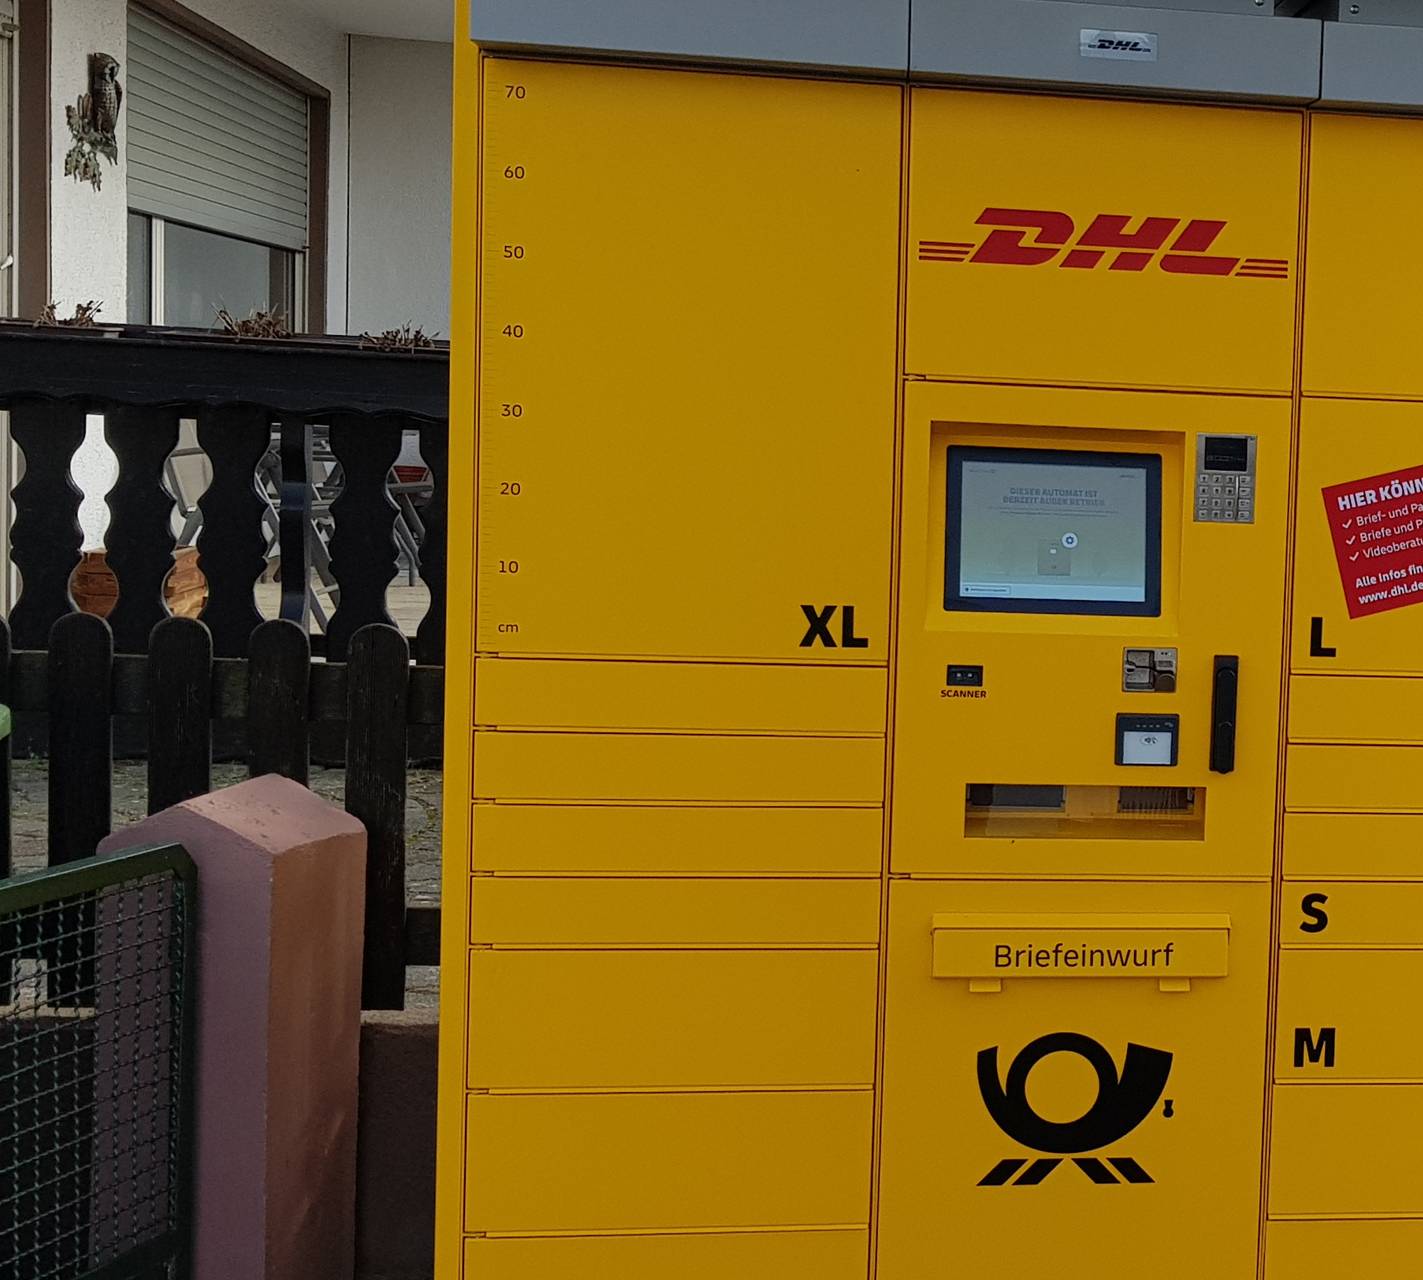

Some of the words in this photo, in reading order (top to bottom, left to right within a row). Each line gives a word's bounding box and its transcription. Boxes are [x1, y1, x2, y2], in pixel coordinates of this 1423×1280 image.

[1097, 39, 1143, 52] DHL
[505, 85, 526, 99] 70
[504, 165, 525, 179] 60
[968, 207, 1241, 277] DHL
[503, 245, 524, 259] 50
[502, 324, 525, 338] 40
[501, 403, 523, 417] 30
[500, 482, 521, 496] 20
[1337, 489, 1378, 511] HIER
[1356, 511, 1387, 527] Brief-
[1388, 506, 1409, 520] und
[1360, 526, 1392, 543] Briefe
[1393, 519, 1415, 534] und
[499, 560, 519, 575] 10
[1355, 576, 1377, 589] Alle
[1378, 567, 1407, 583] Infos
[498, 623, 519, 633] cm
[799, 604, 869, 649] XL
[1309, 616, 1337, 657] L
[940, 689, 987, 699] SCANNER
[1299, 892, 1329, 933] S
[994, 942, 1175, 968] Briefeinwurf
[1293, 1027, 1336, 1068] M
